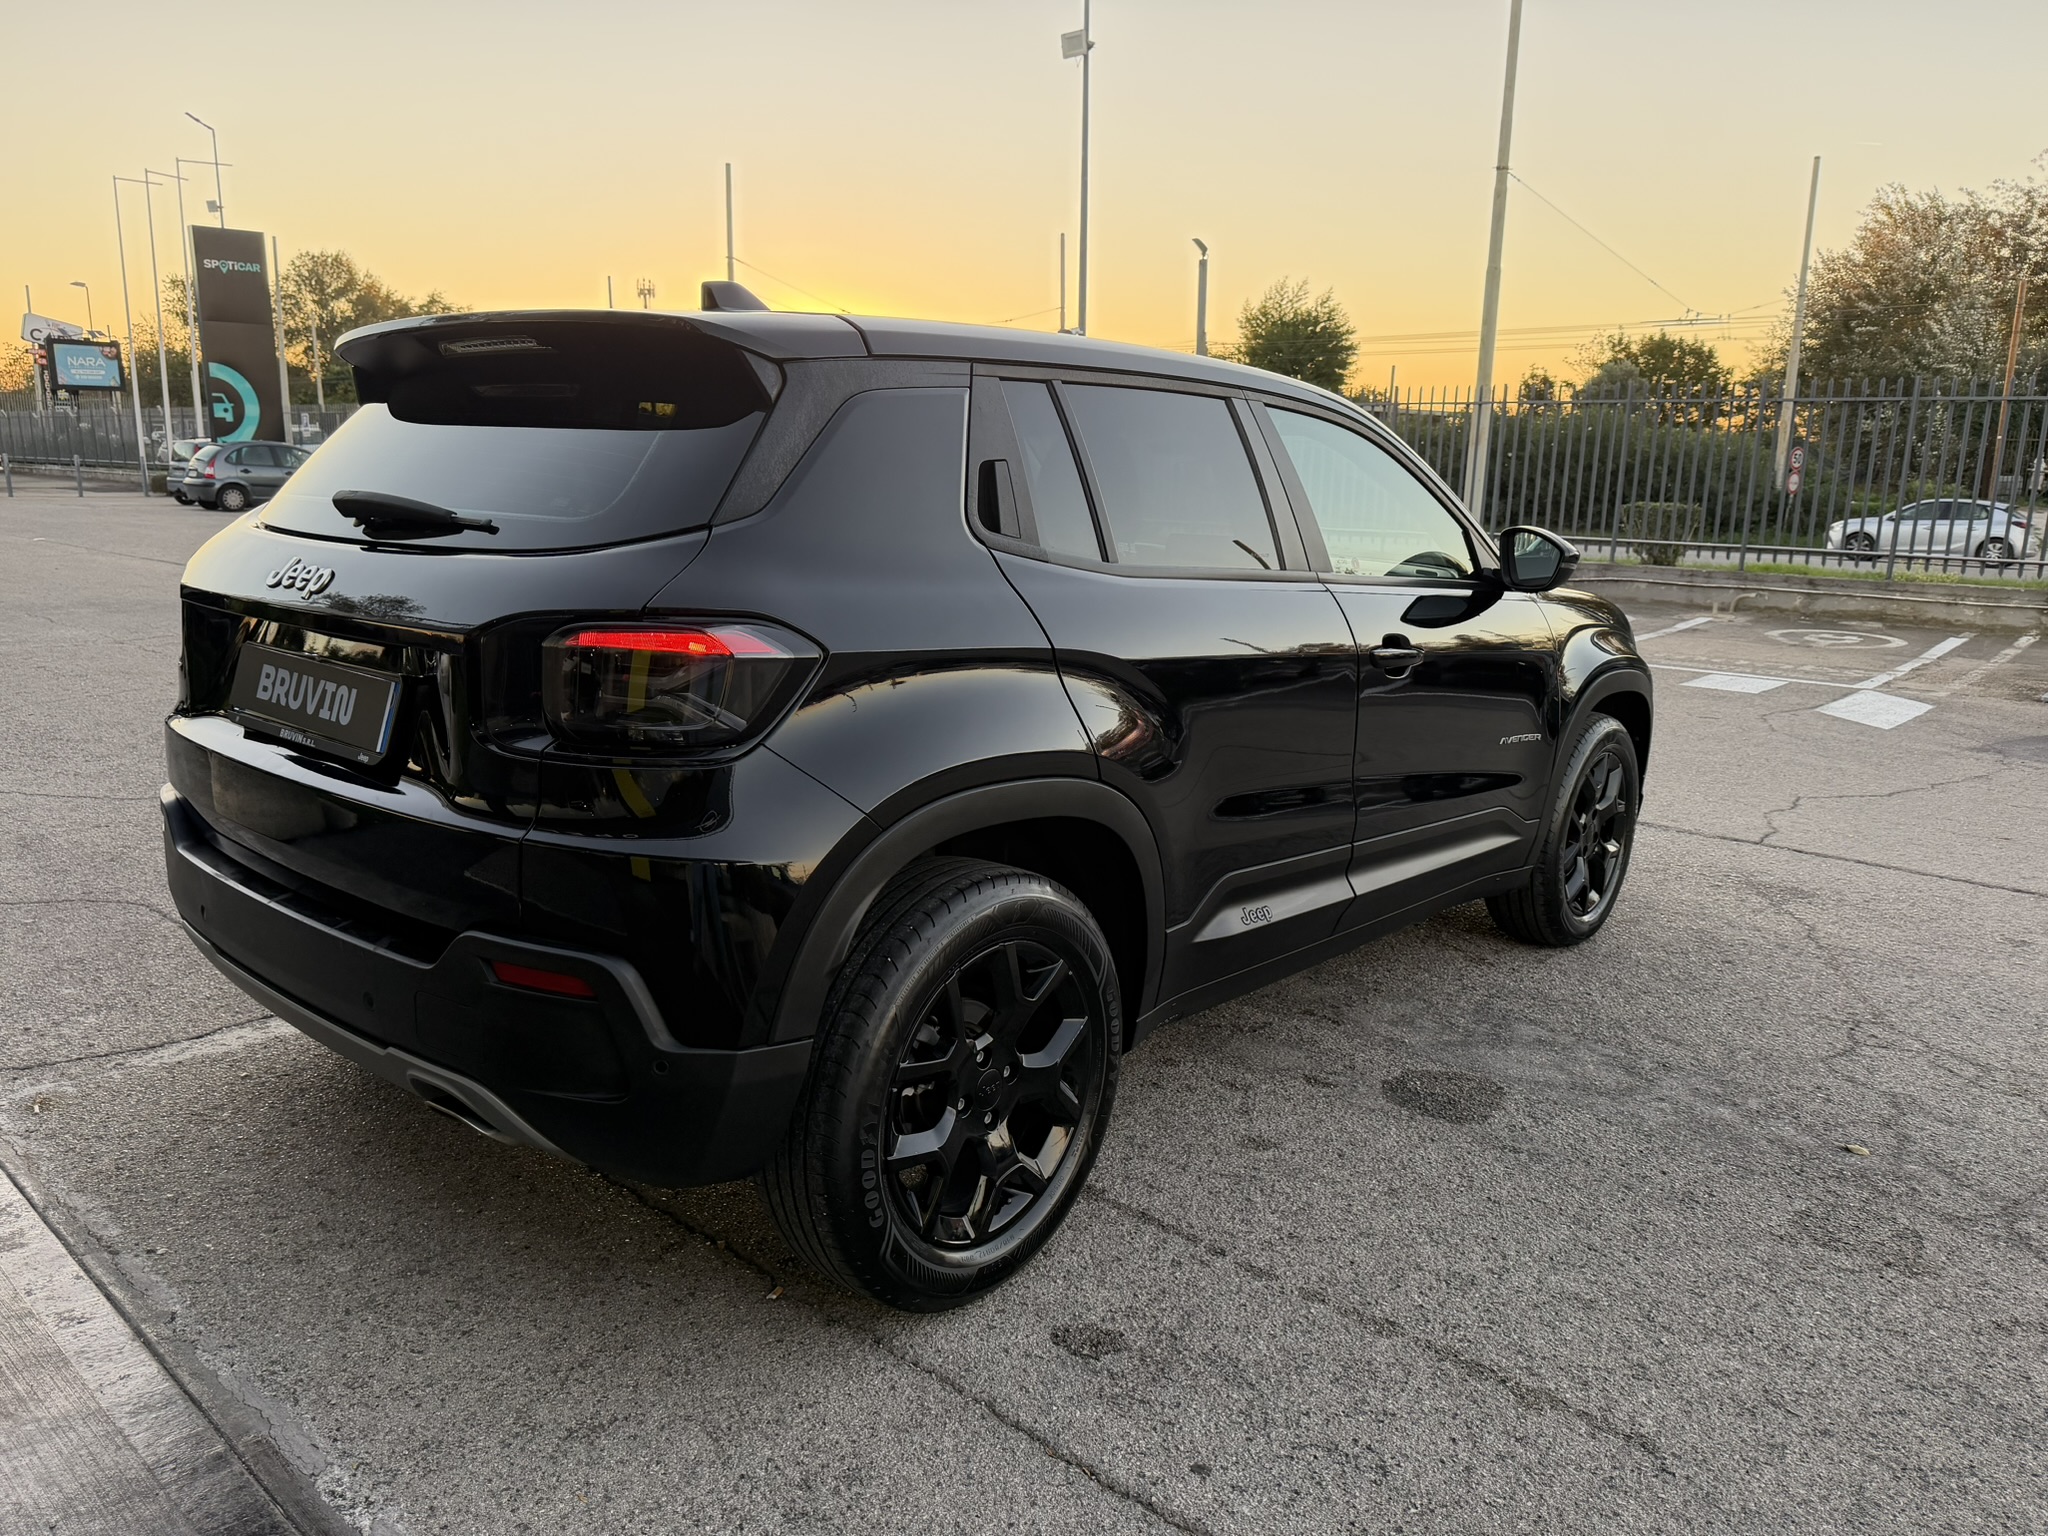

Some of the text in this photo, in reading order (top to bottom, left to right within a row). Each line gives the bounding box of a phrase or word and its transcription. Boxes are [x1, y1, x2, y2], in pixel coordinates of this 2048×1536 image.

[67, 356, 106, 367] NARA
[266, 556, 335, 600] Jeep
[256, 663, 358, 726] BRUVIN
[279, 728, 304, 744] BRUVIN
[1499, 732, 1542, 746] AVENGER
[357, 752, 369, 763] Jeep
[1240, 904, 1273, 926] Jeep
